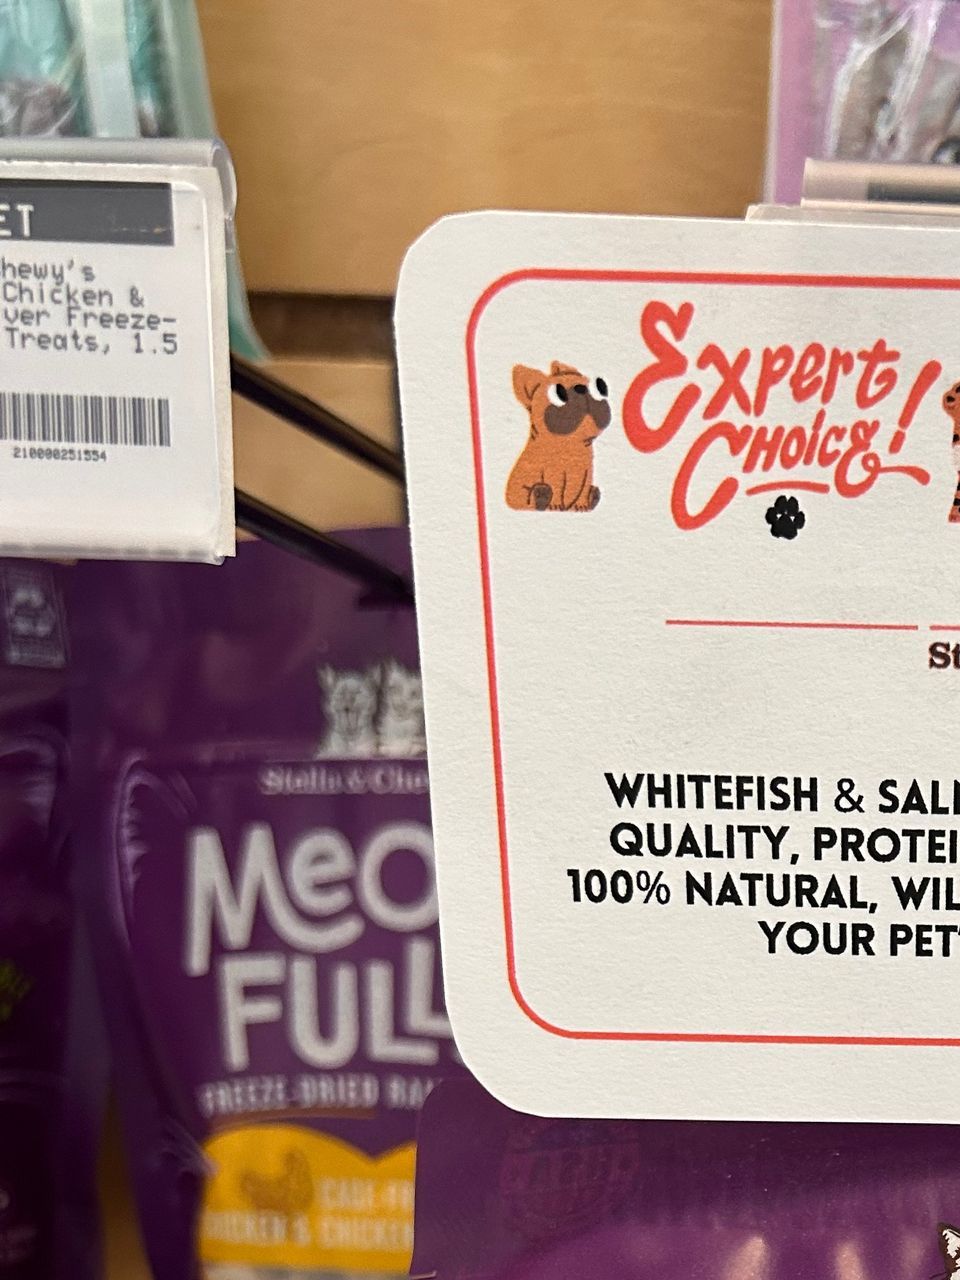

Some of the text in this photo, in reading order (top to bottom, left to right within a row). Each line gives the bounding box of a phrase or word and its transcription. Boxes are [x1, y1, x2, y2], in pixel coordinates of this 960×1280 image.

[3, 281, 145, 308] Chicken &
[67, 306, 177, 331] Freeze-
[5, 326, 178, 355] Treats, 1.5
[622, 300, 900, 453] Expert
[604, 772, 818, 812] WHITEFISH
[834, 778, 865, 814] &
[609, 822, 801, 866] QUALITY,
[566, 868, 671, 905] 100%
[686, 872, 879, 914] NATURAL,
[758, 921, 876, 957] YOUR
[218, 935, 458, 1073] FULL
